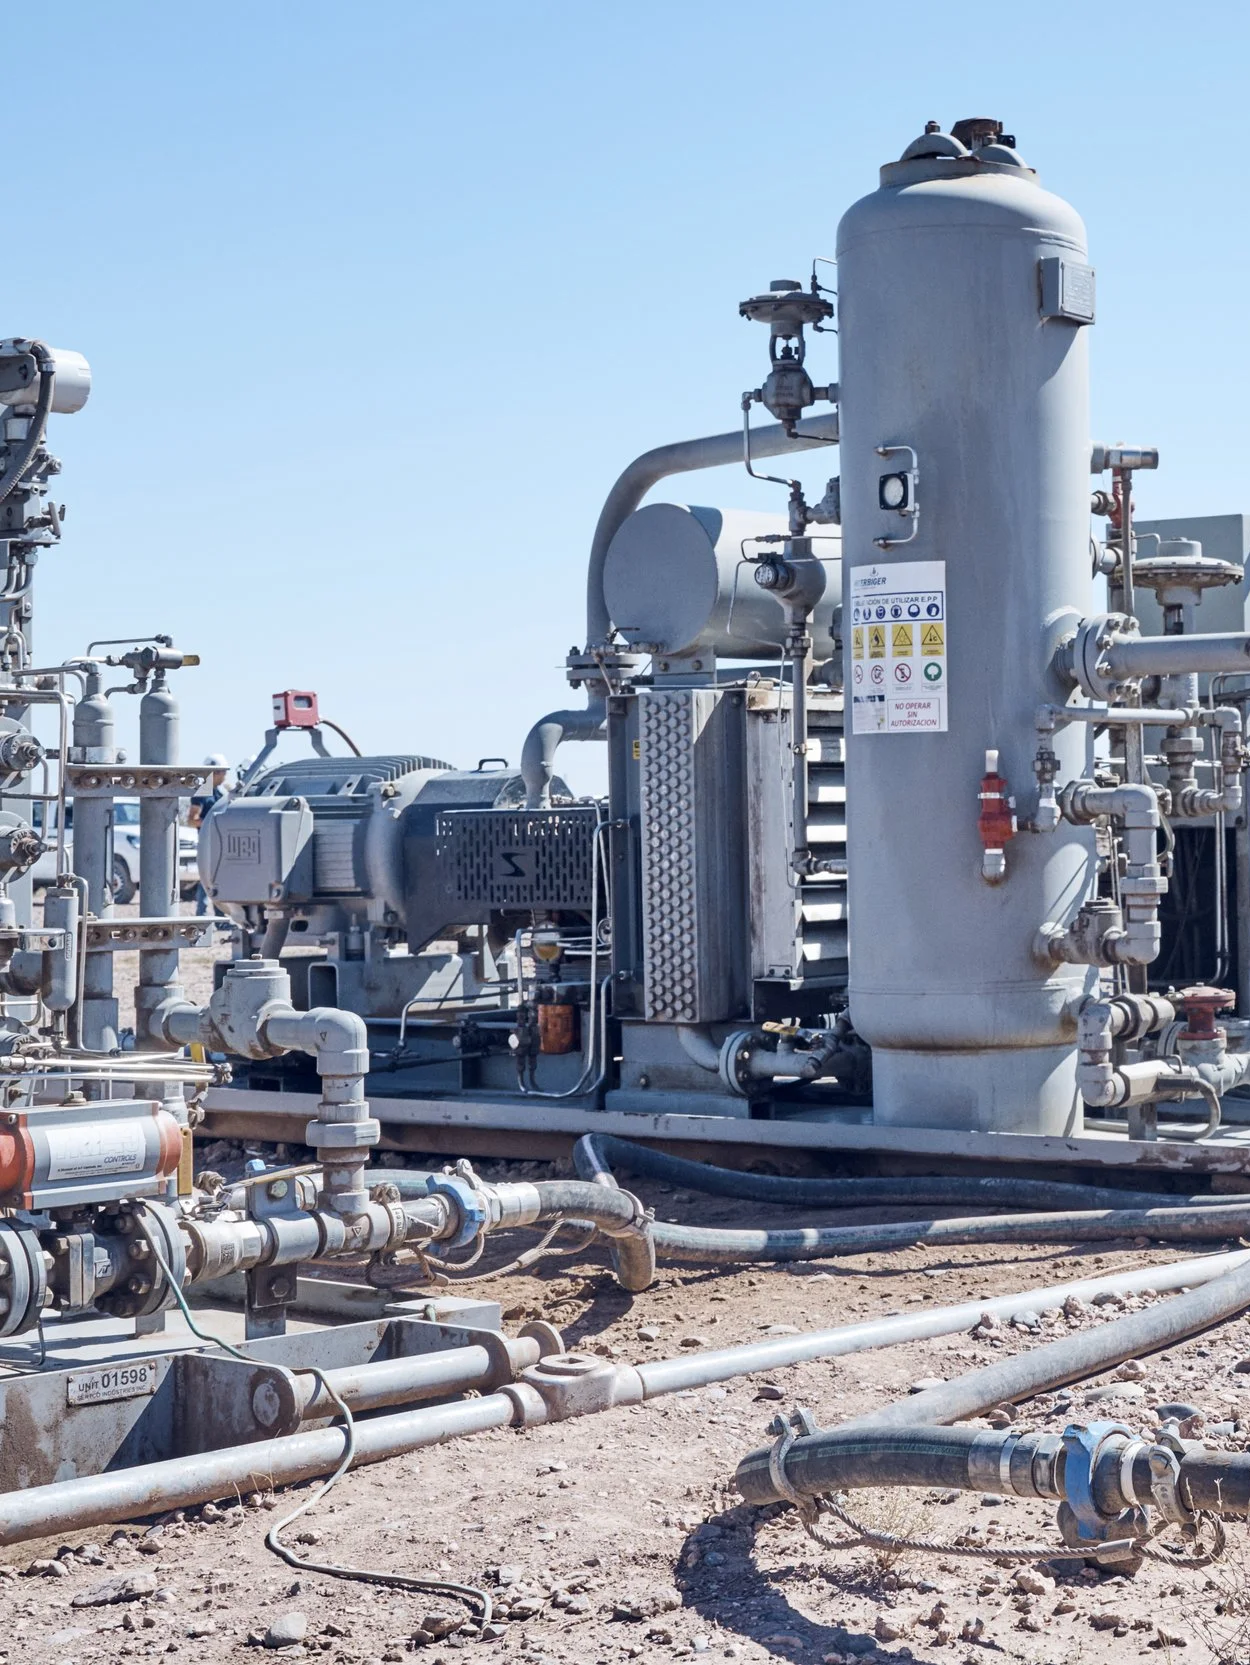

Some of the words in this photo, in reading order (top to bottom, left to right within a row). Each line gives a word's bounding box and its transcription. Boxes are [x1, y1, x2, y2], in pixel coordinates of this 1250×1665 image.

[891, 596, 919, 604] UTILIZAR
[905, 702, 931, 710] OPERAR
[104, 1154, 137, 1163] CONTROLS
[78, 1380, 99, 1391] UNIT
[101, 1368, 147, 1388] 01598
[102, 1386, 135, 1397] INDUSTRIES
